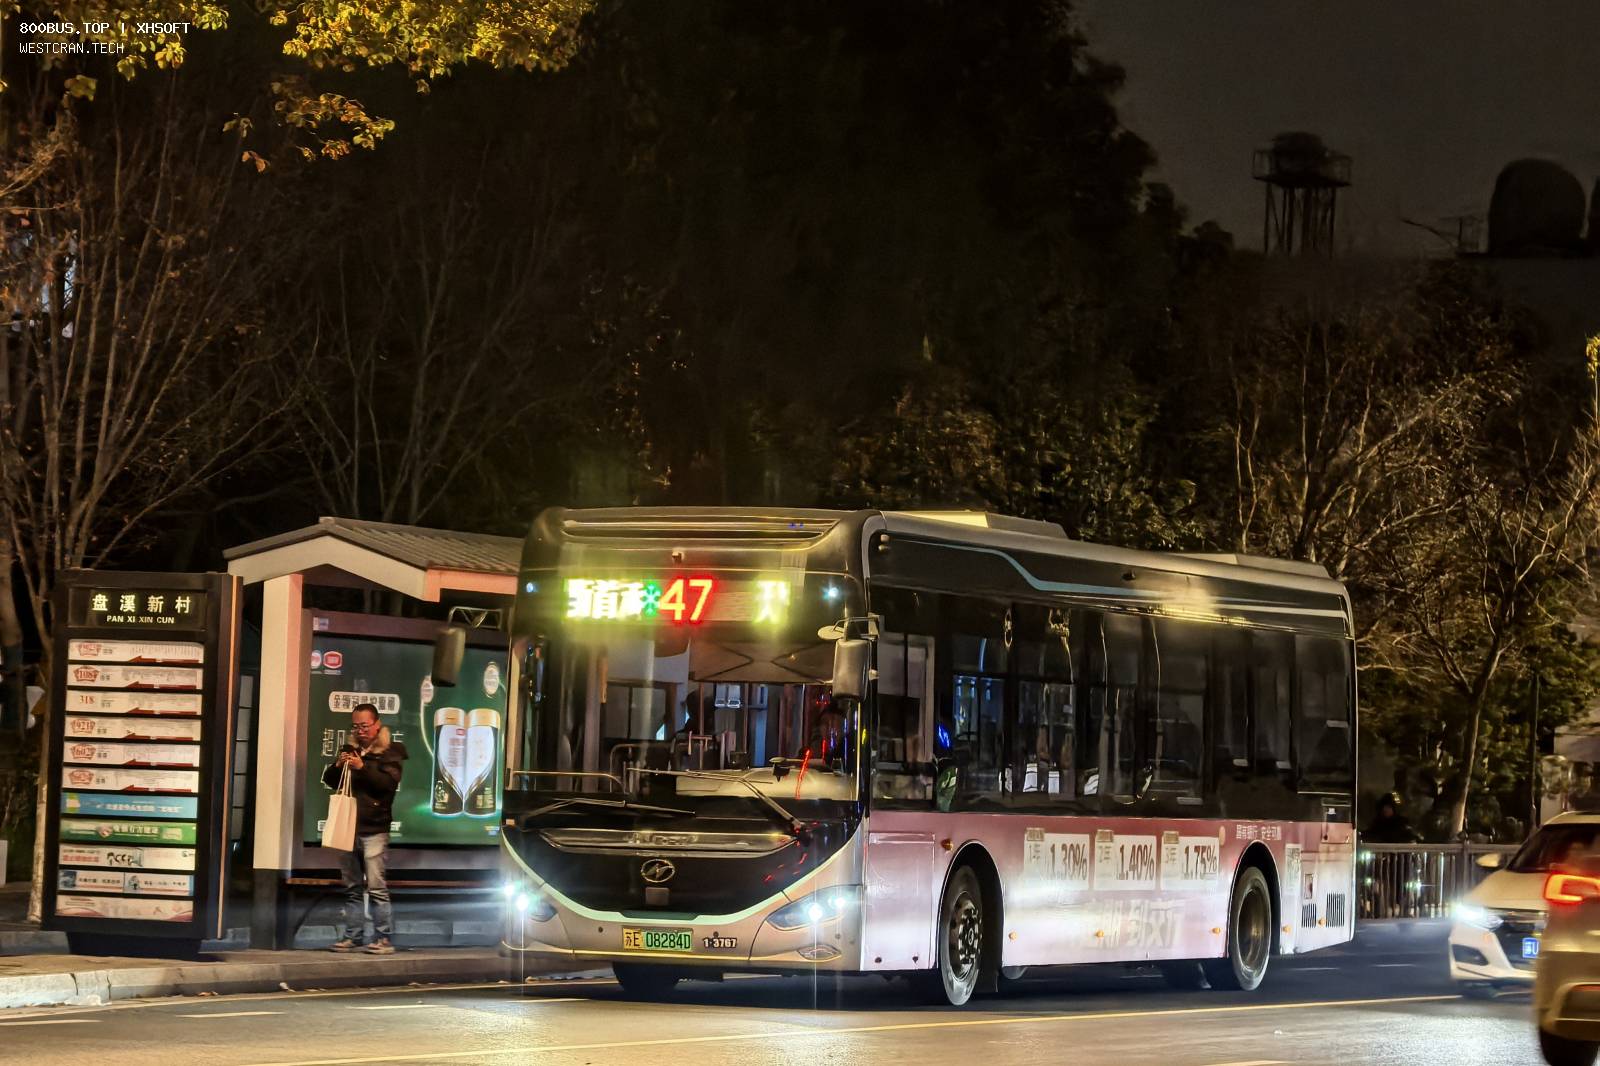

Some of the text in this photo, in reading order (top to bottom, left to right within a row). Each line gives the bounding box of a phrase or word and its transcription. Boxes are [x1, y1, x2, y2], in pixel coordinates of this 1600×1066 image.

[91, 593, 192, 614] 盘溪新村
[658, 578, 713, 621] 47
[106, 615, 175, 625] PAN XI XIN CUN
[1119, 844, 1155, 880] 1.40%
[1183, 844, 1217, 880] 1.75%
